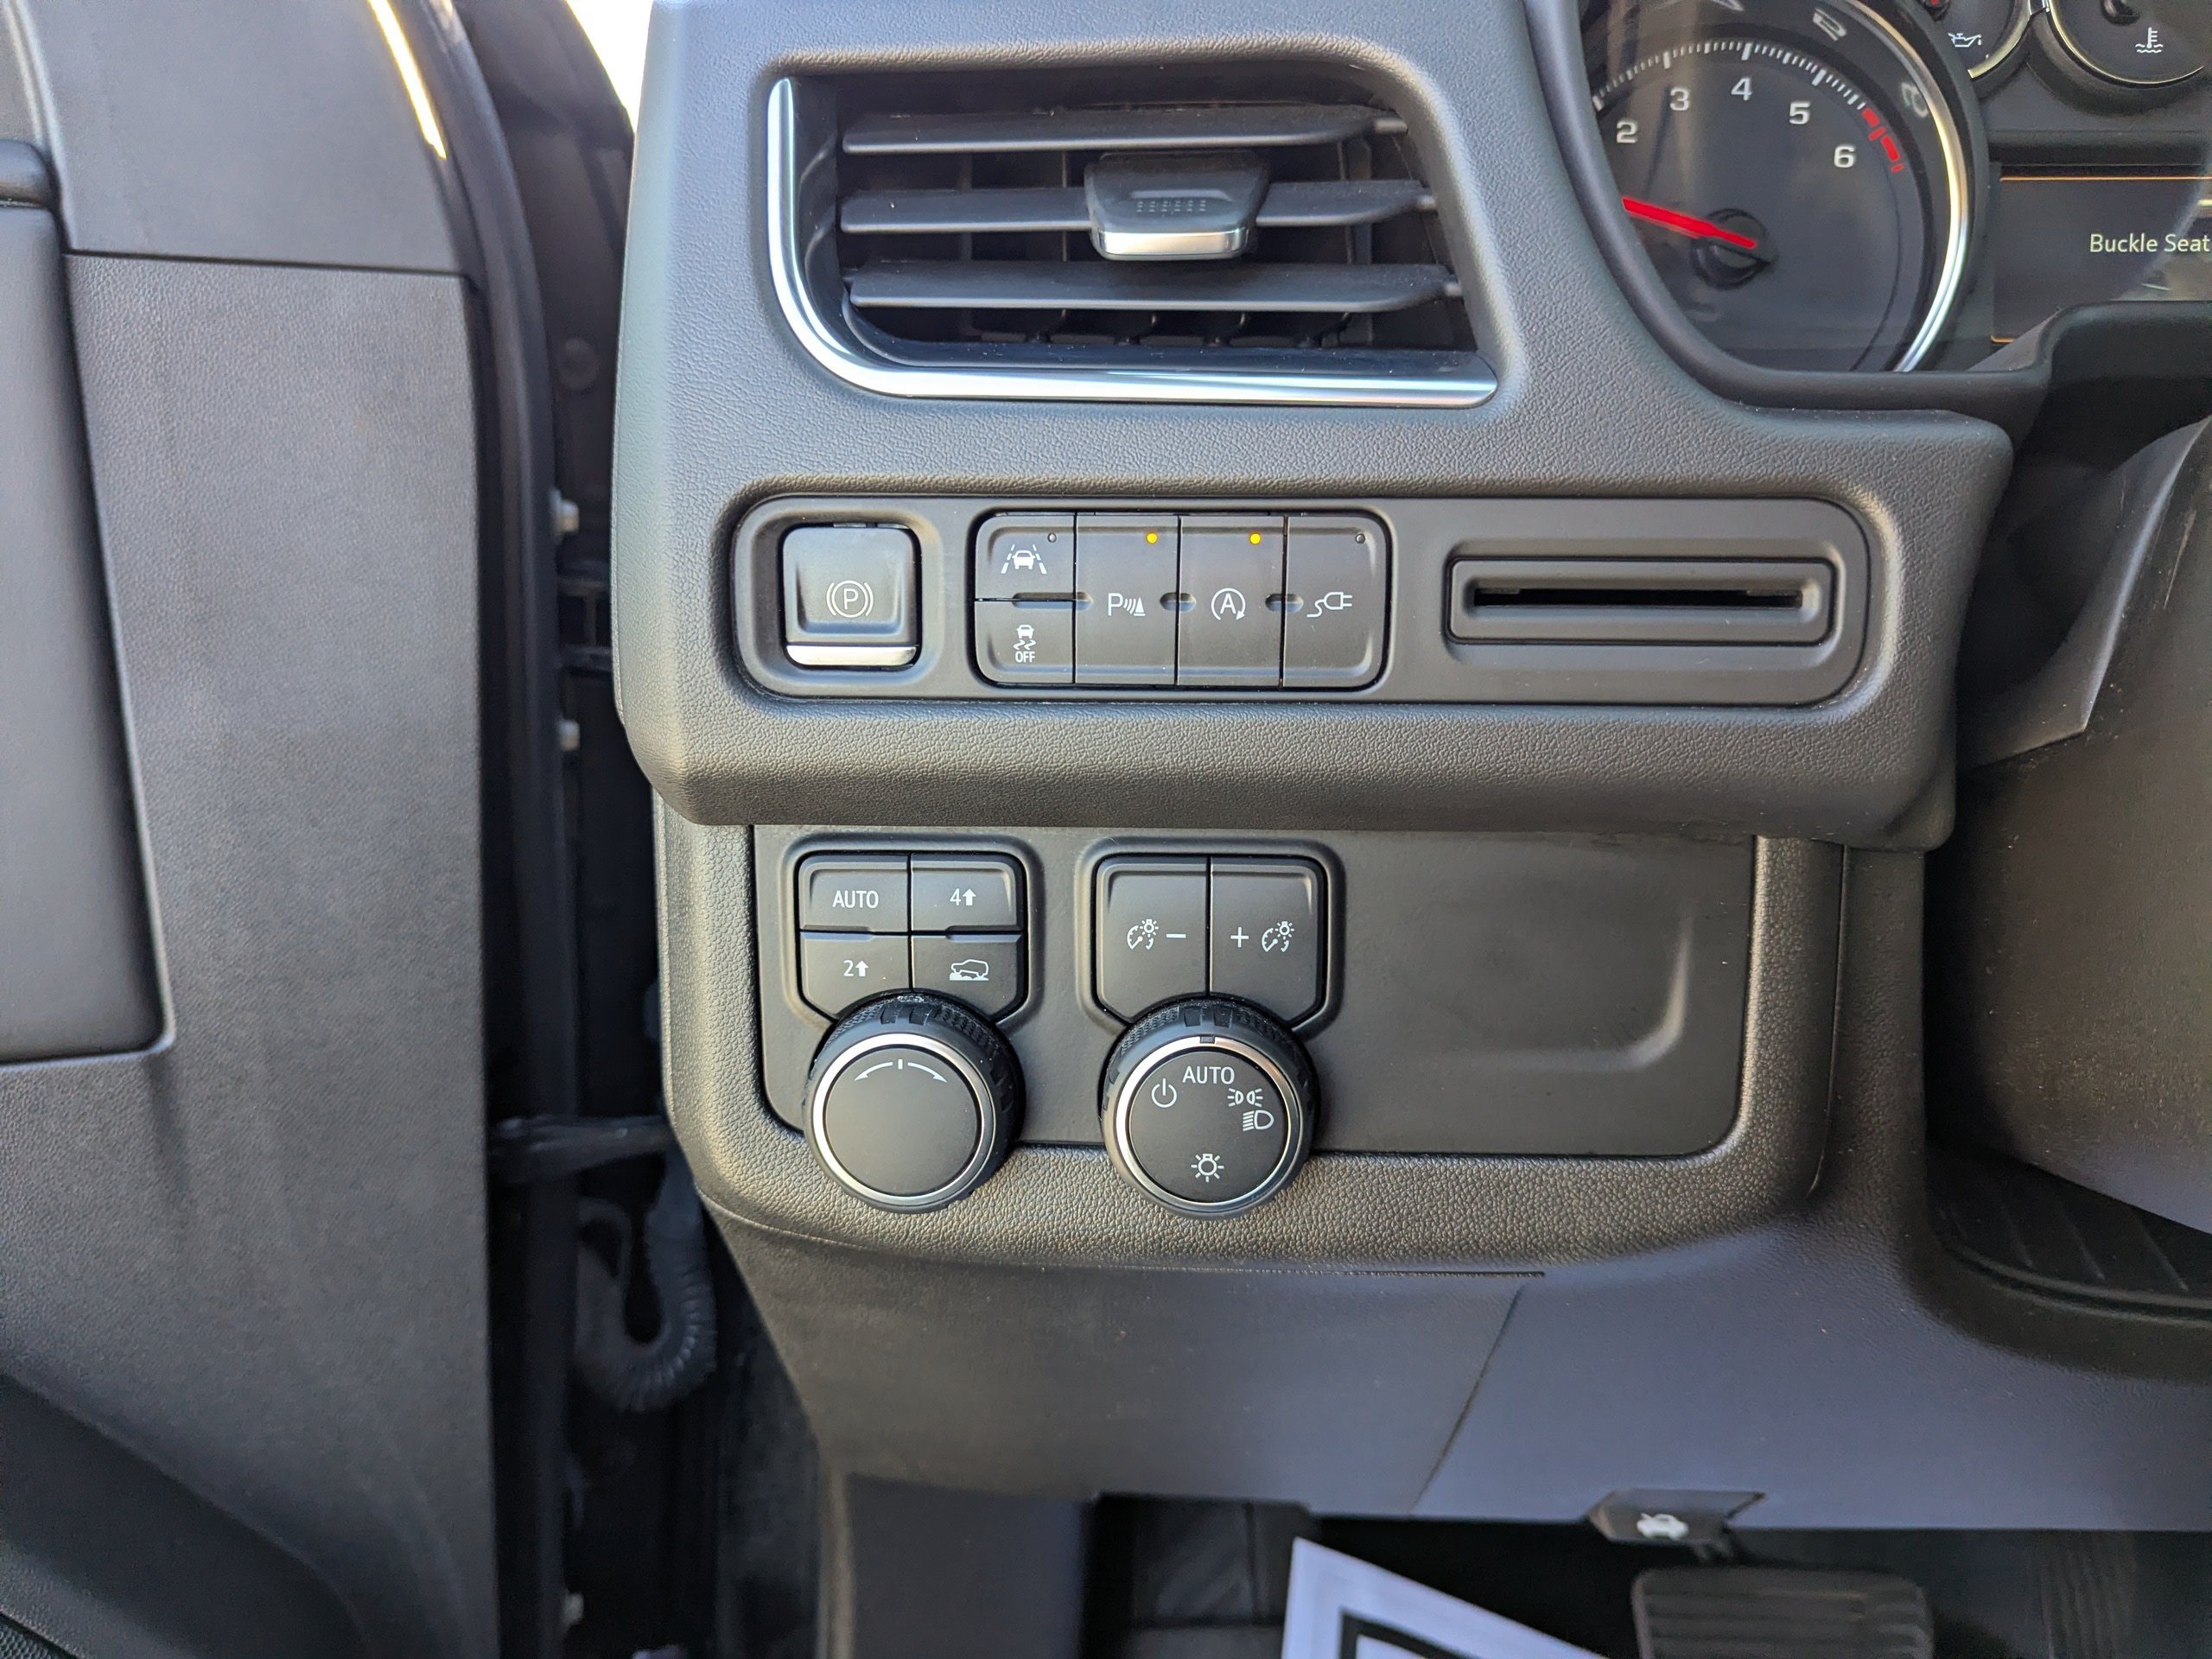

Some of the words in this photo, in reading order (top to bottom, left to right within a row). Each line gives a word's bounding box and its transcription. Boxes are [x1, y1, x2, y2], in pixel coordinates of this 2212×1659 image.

[1669, 86, 1691, 111] 3
[1731, 76, 1753, 101] 4
[1789, 100, 1811, 125] 5
[1615, 119, 1638, 144] 2
[1833, 144, 1857, 168] 6
[2089, 232, 2158, 253] Buckle
[2164, 233, 2210, 253] Seat
[843, 588, 859, 610] P
[1108, 592, 1124, 617] P
[1219, 593, 1236, 614] A
[1014, 651, 1036, 664] OFF
[832, 889, 880, 909] AUTO
[950, 888, 962, 906] 4
[842, 960, 855, 977] 2
[1181, 1065, 1236, 1085] AUTO
